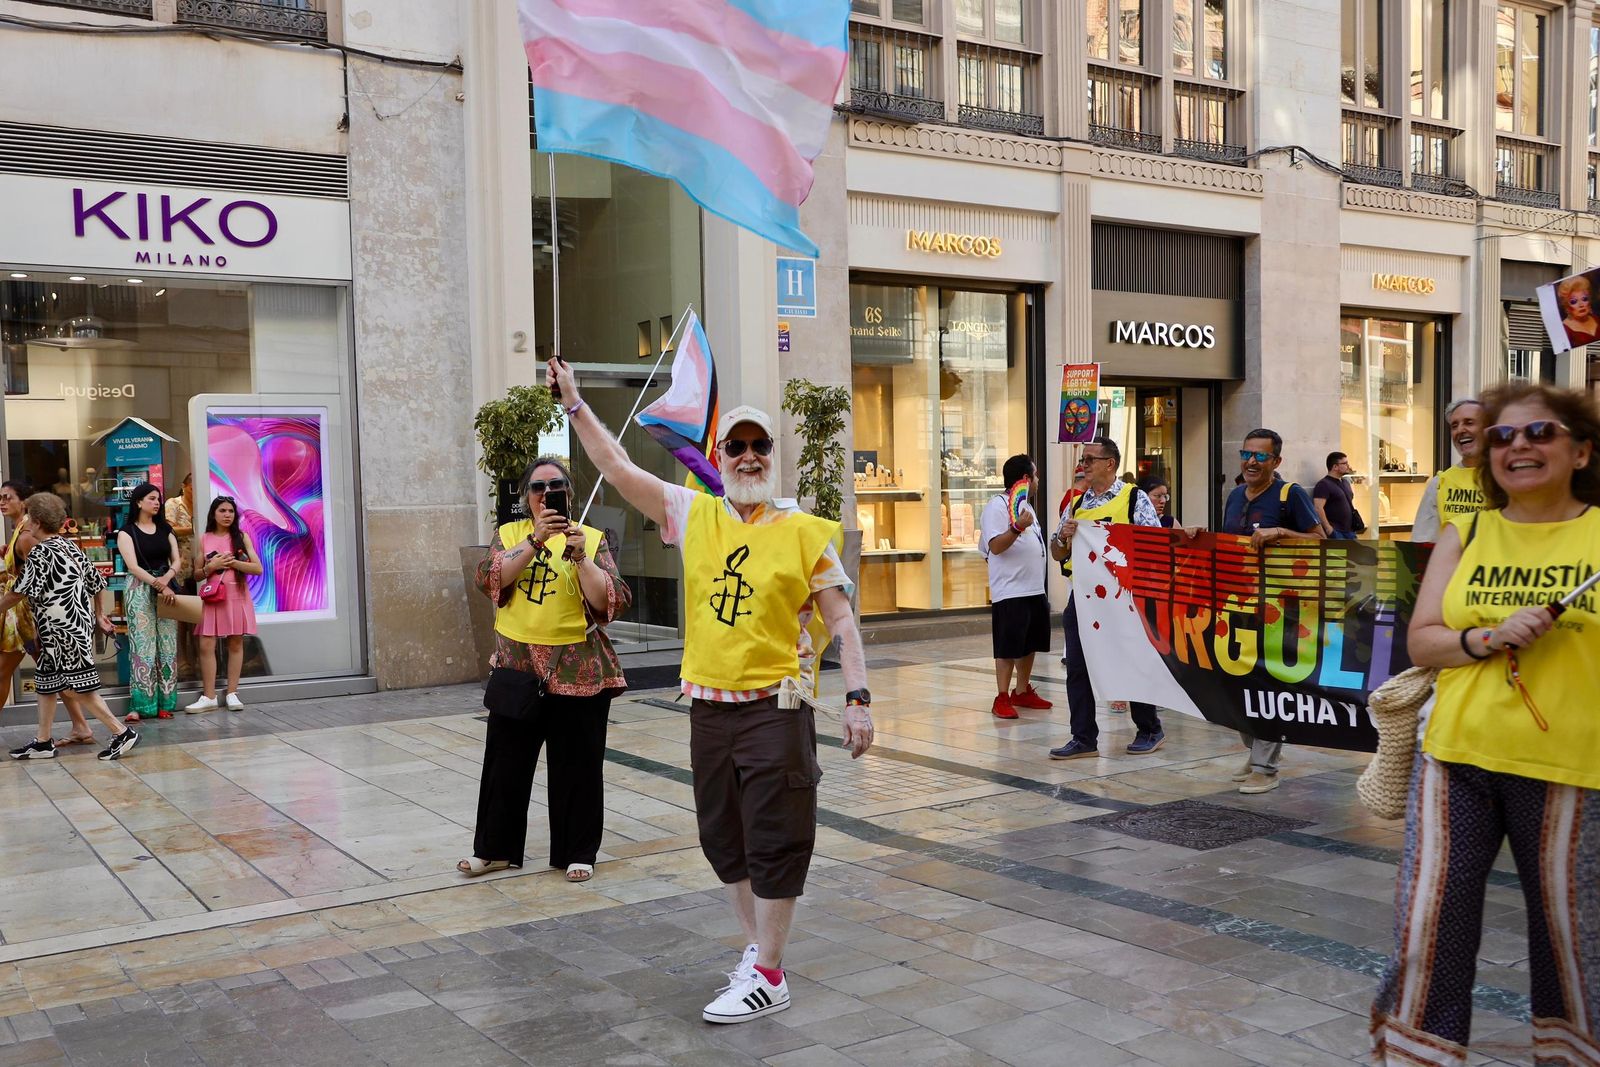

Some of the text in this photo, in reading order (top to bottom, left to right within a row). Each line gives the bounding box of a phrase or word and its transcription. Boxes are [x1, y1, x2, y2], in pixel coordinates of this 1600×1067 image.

[72, 188, 278, 247] KIKO
[907, 229, 1003, 258] MARCOS
[135, 251, 228, 267] MILANO
[785, 269, 805, 297] H
[1371, 272, 1436, 295] MARCOS
[877, 325, 903, 337] Seiko
[952, 320, 1001, 335] LONGIN
[1115, 319, 1216, 349] MARCOS
[513, 330, 528, 353] 2
[1066, 369, 1095, 379] SUPPORT
[1066, 378, 1093, 388] LGBTQ+
[1066, 387, 1090, 397] RIGHTS
[1446, 488, 1485, 504] AMNIS
[1243, 688, 1338, 726] LUCHA
[1338, 701, 1358, 727] Y
